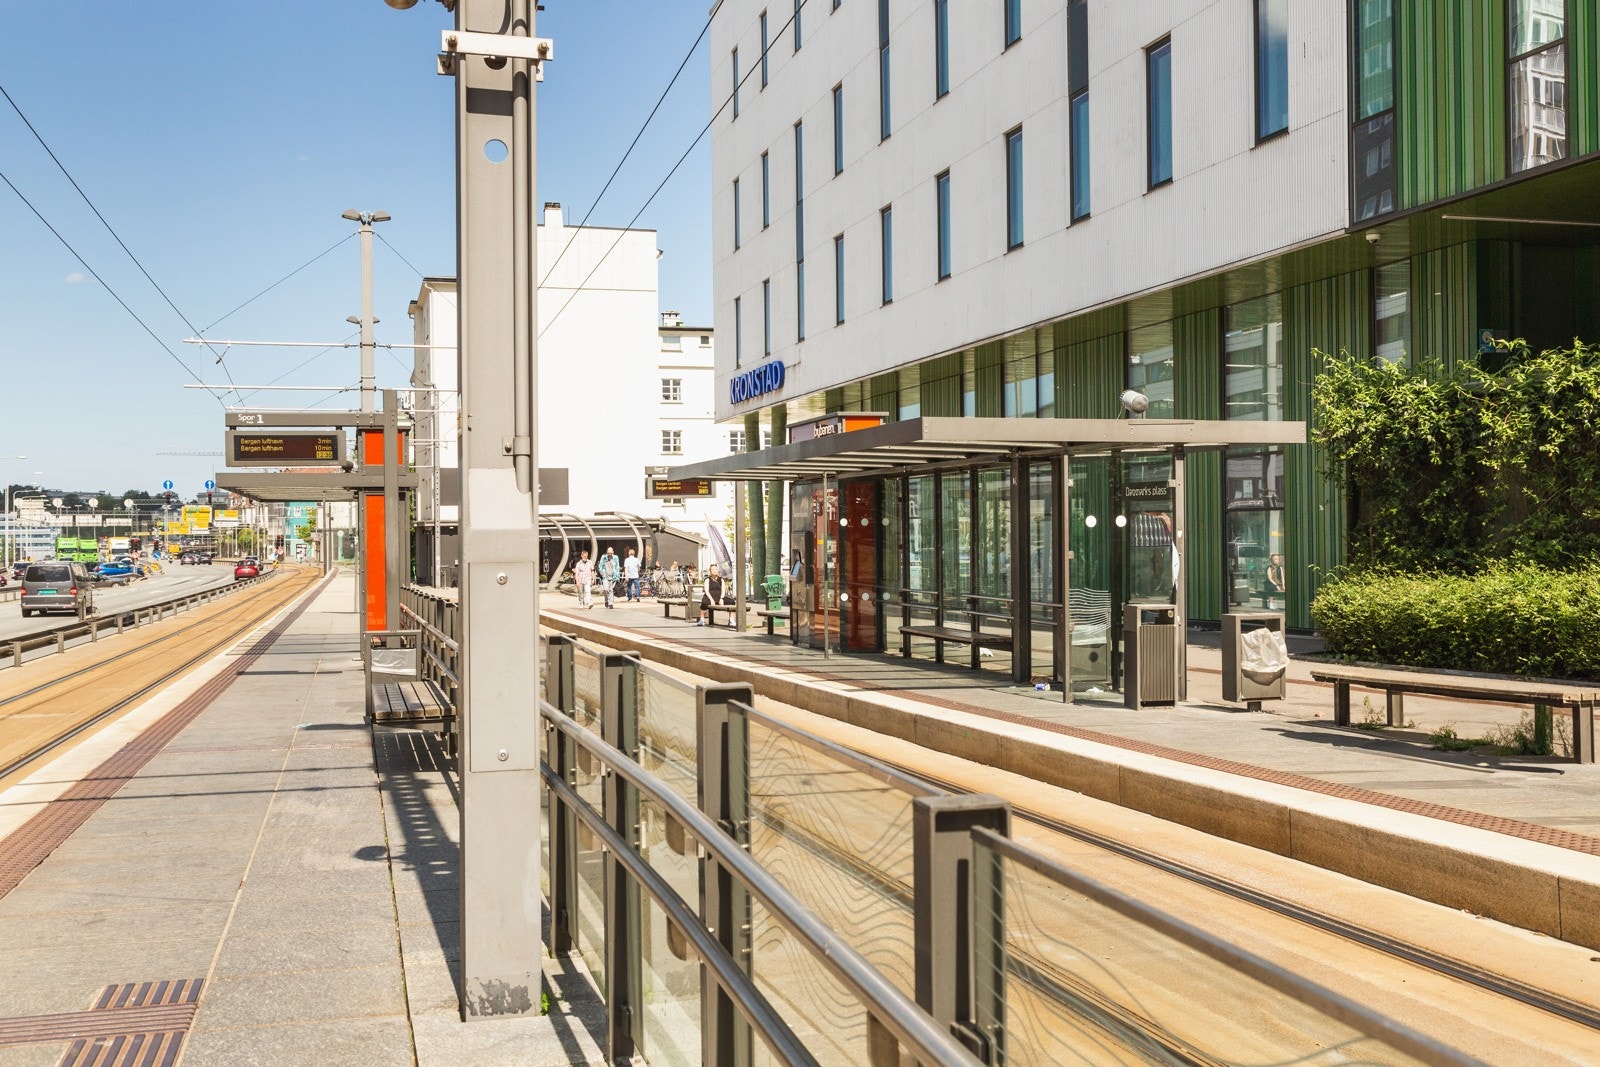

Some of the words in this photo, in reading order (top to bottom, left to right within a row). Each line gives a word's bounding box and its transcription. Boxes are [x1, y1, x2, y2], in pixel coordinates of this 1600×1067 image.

[730, 361, 785, 404] KRONSTAD
[238, 414, 255, 422] Spor
[256, 414, 264, 424] 1
[1152, 486, 1167, 496] plass
